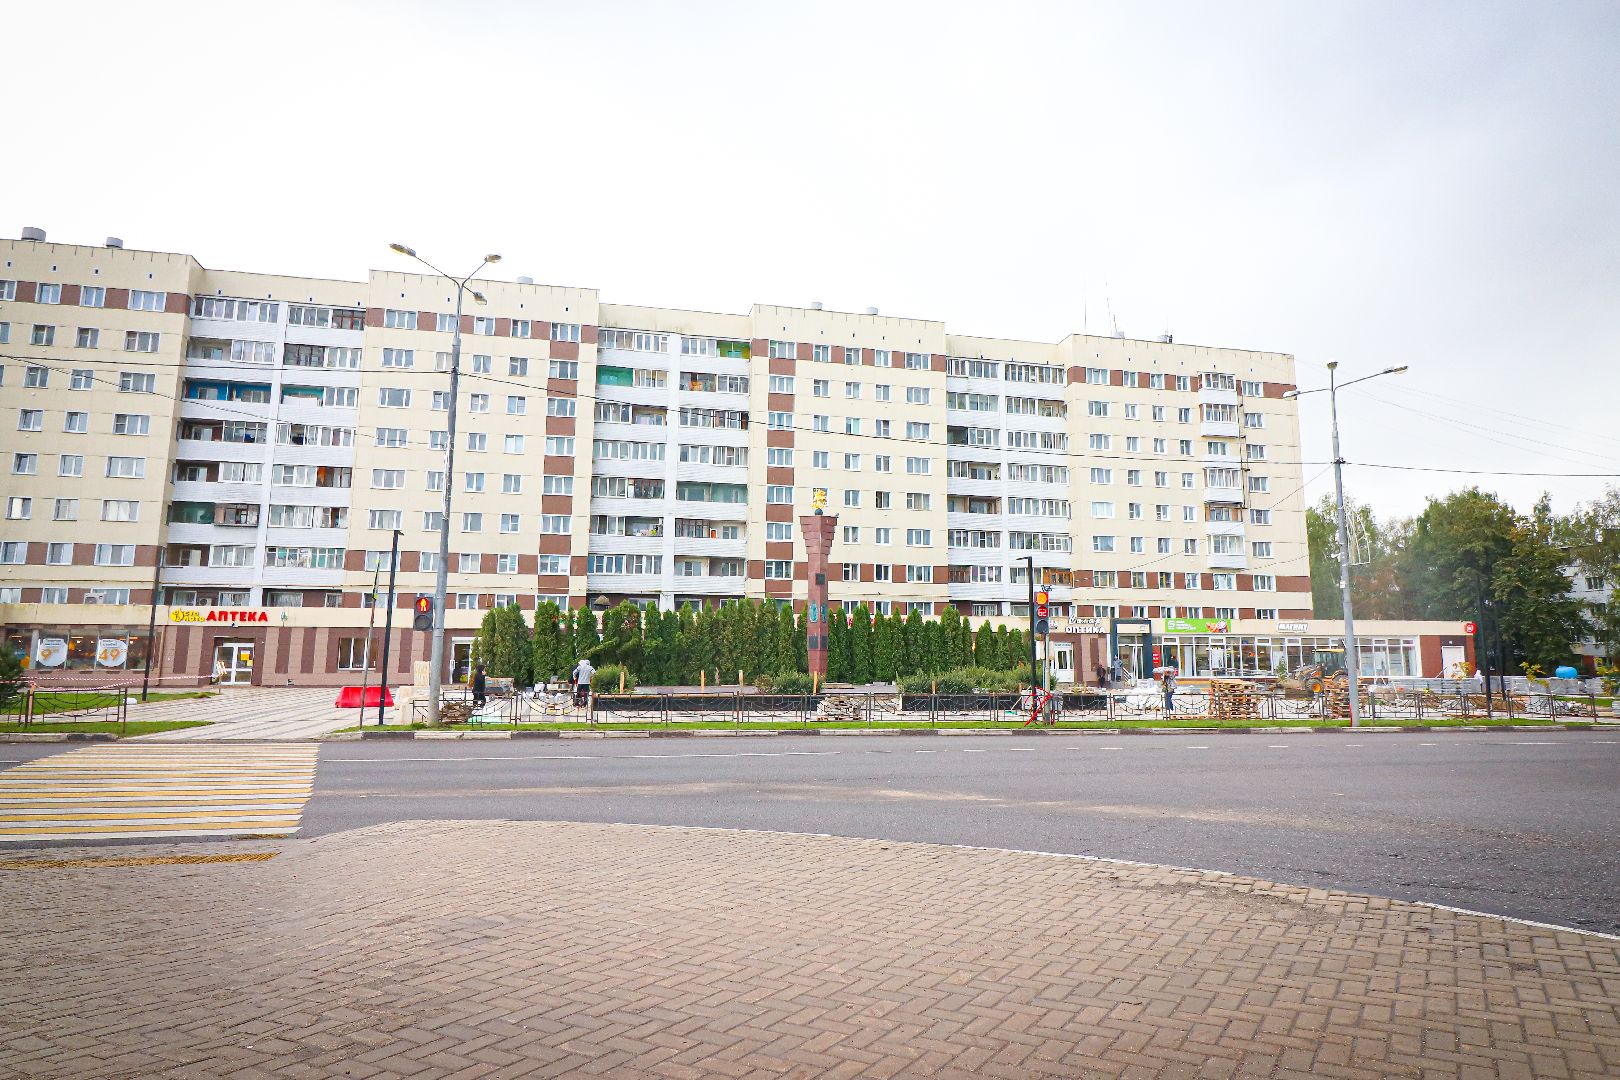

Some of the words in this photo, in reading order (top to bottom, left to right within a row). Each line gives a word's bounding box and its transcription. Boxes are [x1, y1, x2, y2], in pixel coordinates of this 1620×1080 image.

[206, 610, 268, 622] АПТЕКА
[1037, 608, 1047, 617] 62
[1065, 626, 1106, 634] ОПТИКА
